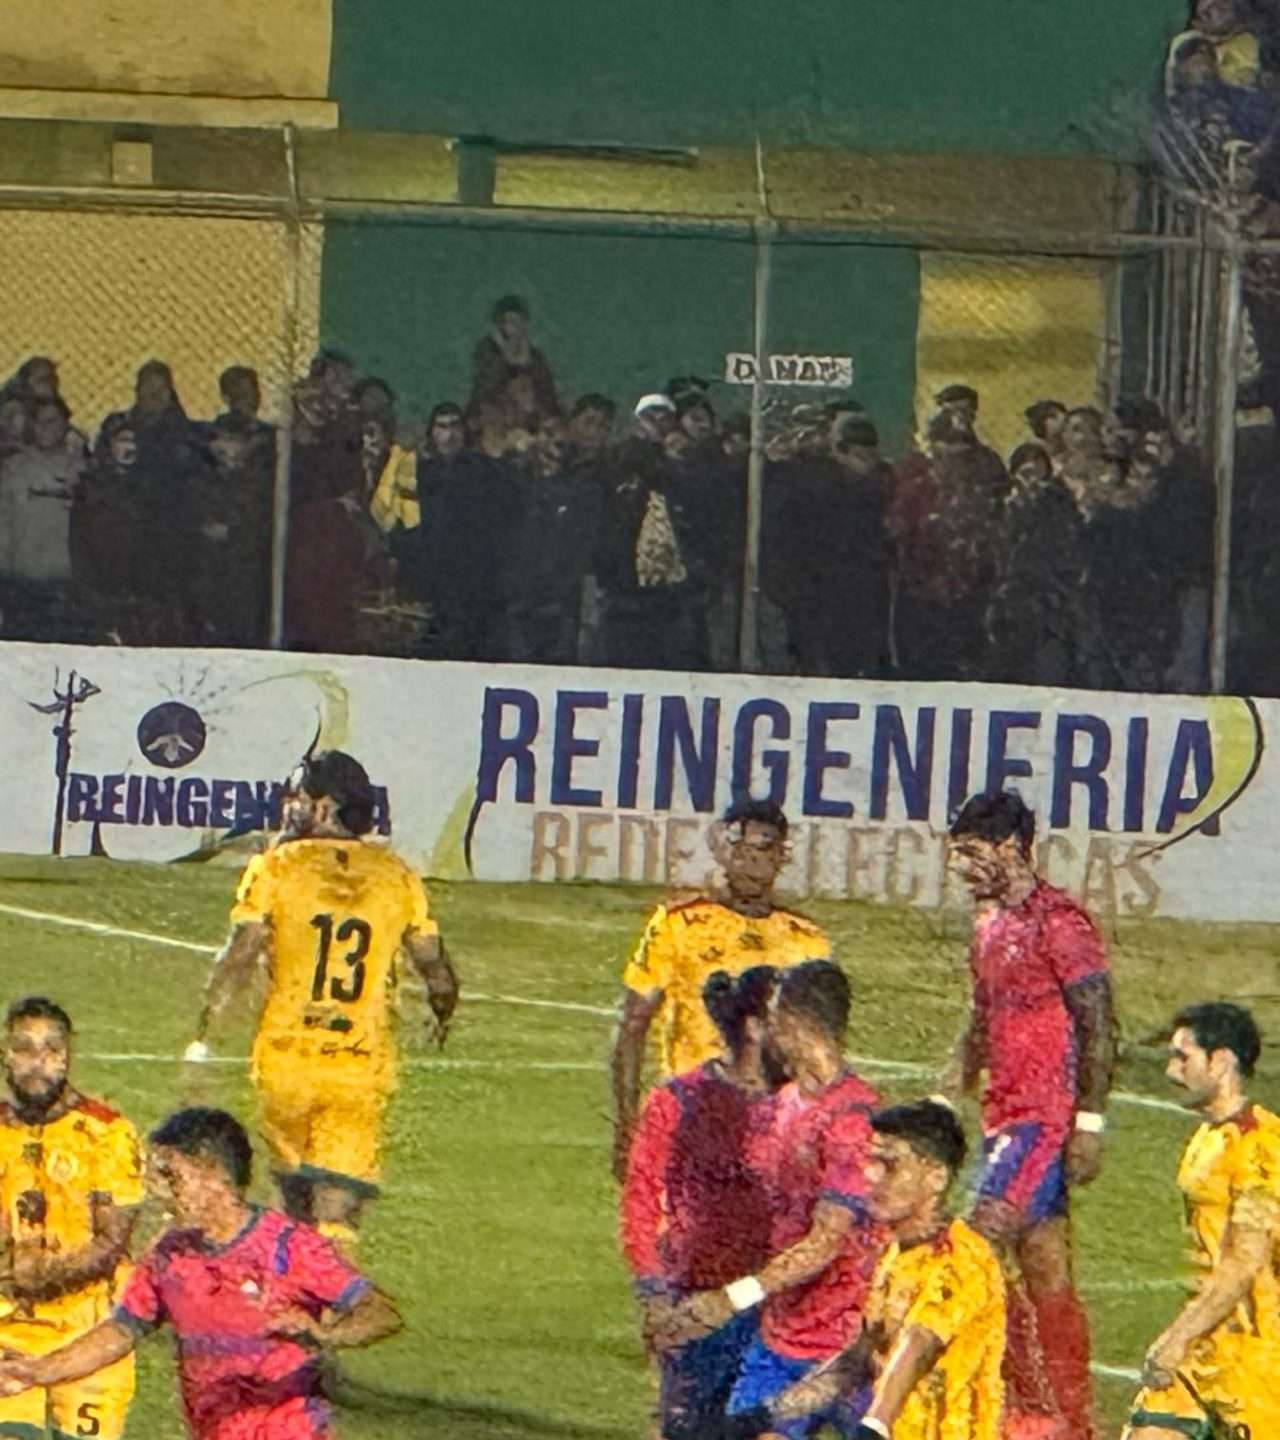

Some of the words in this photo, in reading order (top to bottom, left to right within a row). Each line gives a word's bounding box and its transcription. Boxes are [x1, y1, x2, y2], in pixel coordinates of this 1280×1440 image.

[475, 685, 1223, 838] REINGENIERIA
[309, 913, 373, 1004] 13
[76, 1402, 101, 1437] 5
